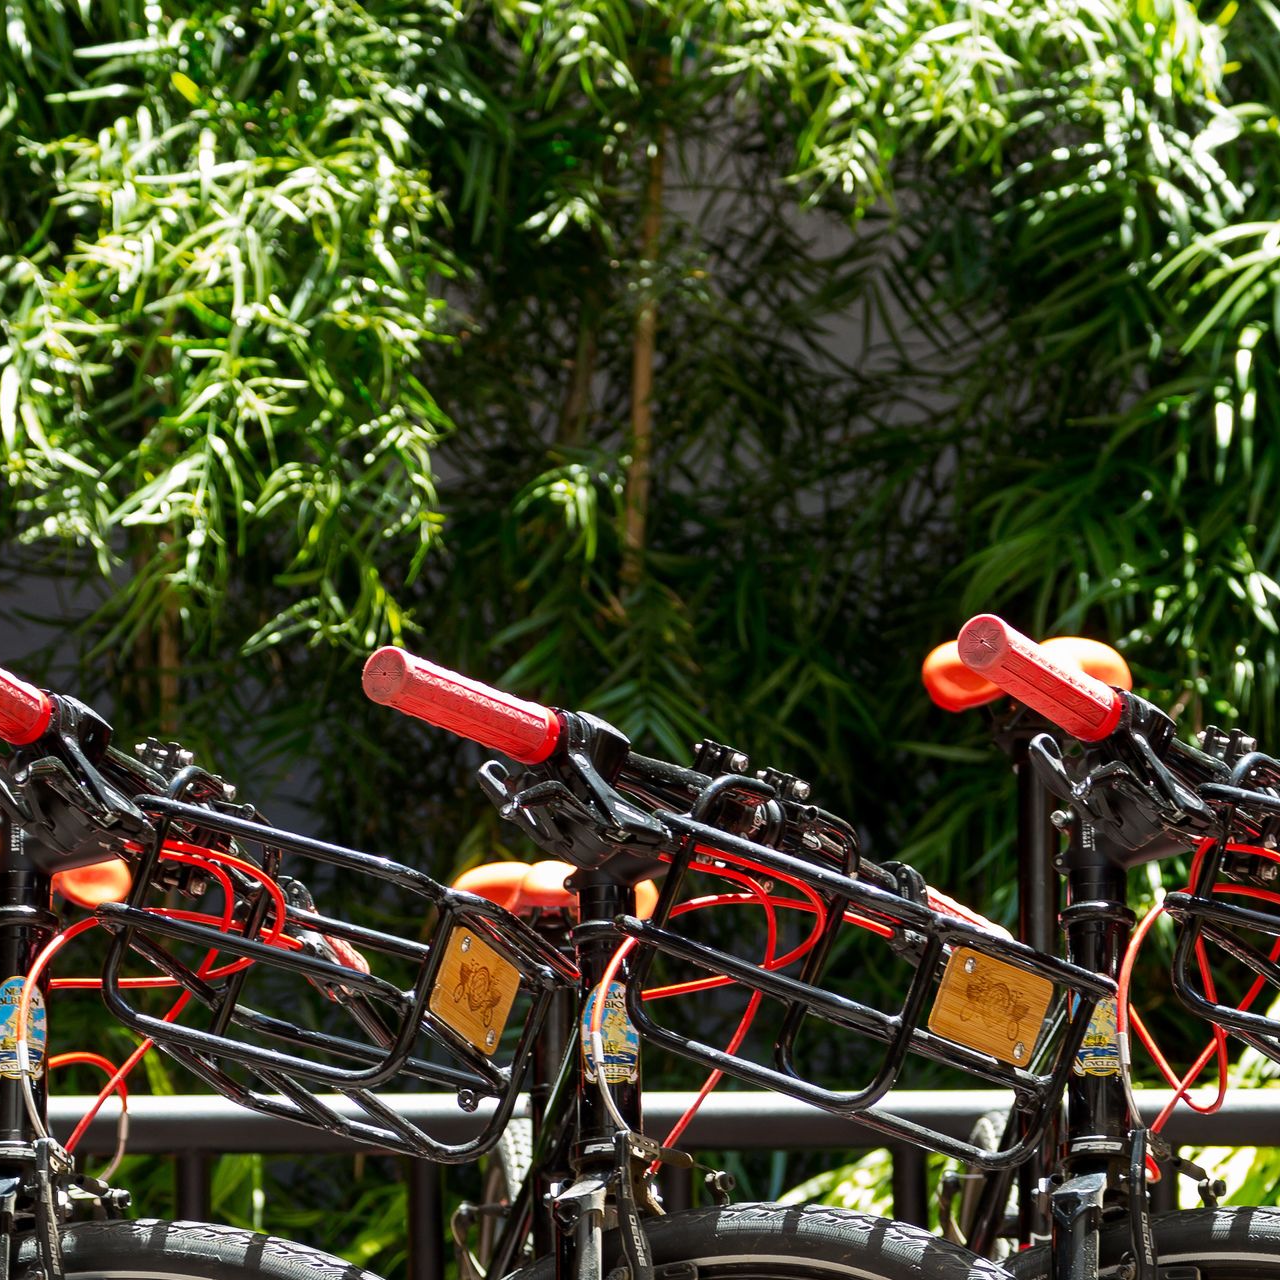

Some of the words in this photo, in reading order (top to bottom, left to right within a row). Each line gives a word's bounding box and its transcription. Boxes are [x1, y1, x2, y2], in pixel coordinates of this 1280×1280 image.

[584, 1142, 616, 1154] FS
[46, 1221, 62, 1276] DEORE
[628, 1214, 648, 1268] DEORE
[1140, 1211, 1154, 1266] DEORE
